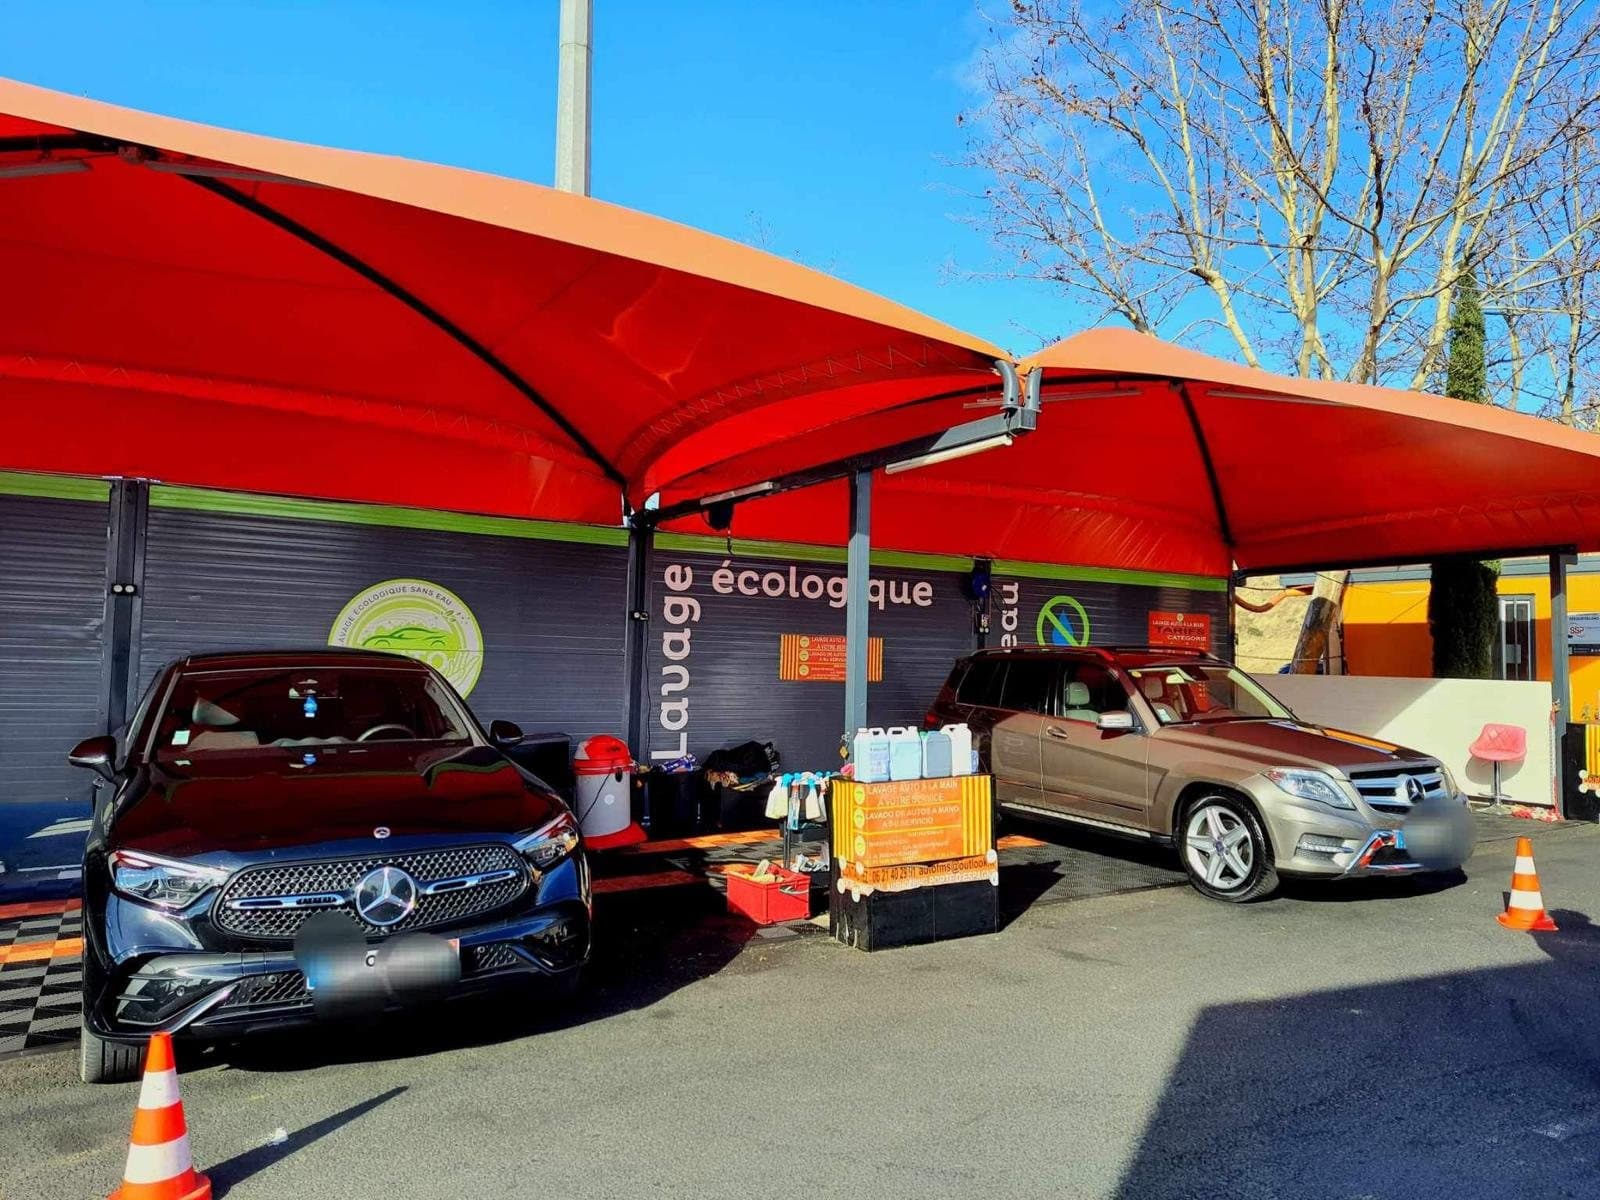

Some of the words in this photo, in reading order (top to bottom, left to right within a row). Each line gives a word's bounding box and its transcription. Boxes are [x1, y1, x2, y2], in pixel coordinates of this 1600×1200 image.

[338, 615, 354, 645] AVAGE
[410, 586, 434, 597] SANS
[435, 593, 453, 606] EAU
[1001, 582, 1019, 653] eau
[651, 564, 701, 759] Lavage
[712, 560, 933, 609] écologque
[865, 809, 894, 820] LAVADO
[895, 809, 905, 818] DE
[906, 807, 932, 817] AUTOS
[939, 805, 960, 814] MANO
[868, 784, 897, 795] LAVAGE
[900, 783, 920, 793] AUTO
[940, 780, 958, 790] MAIN
